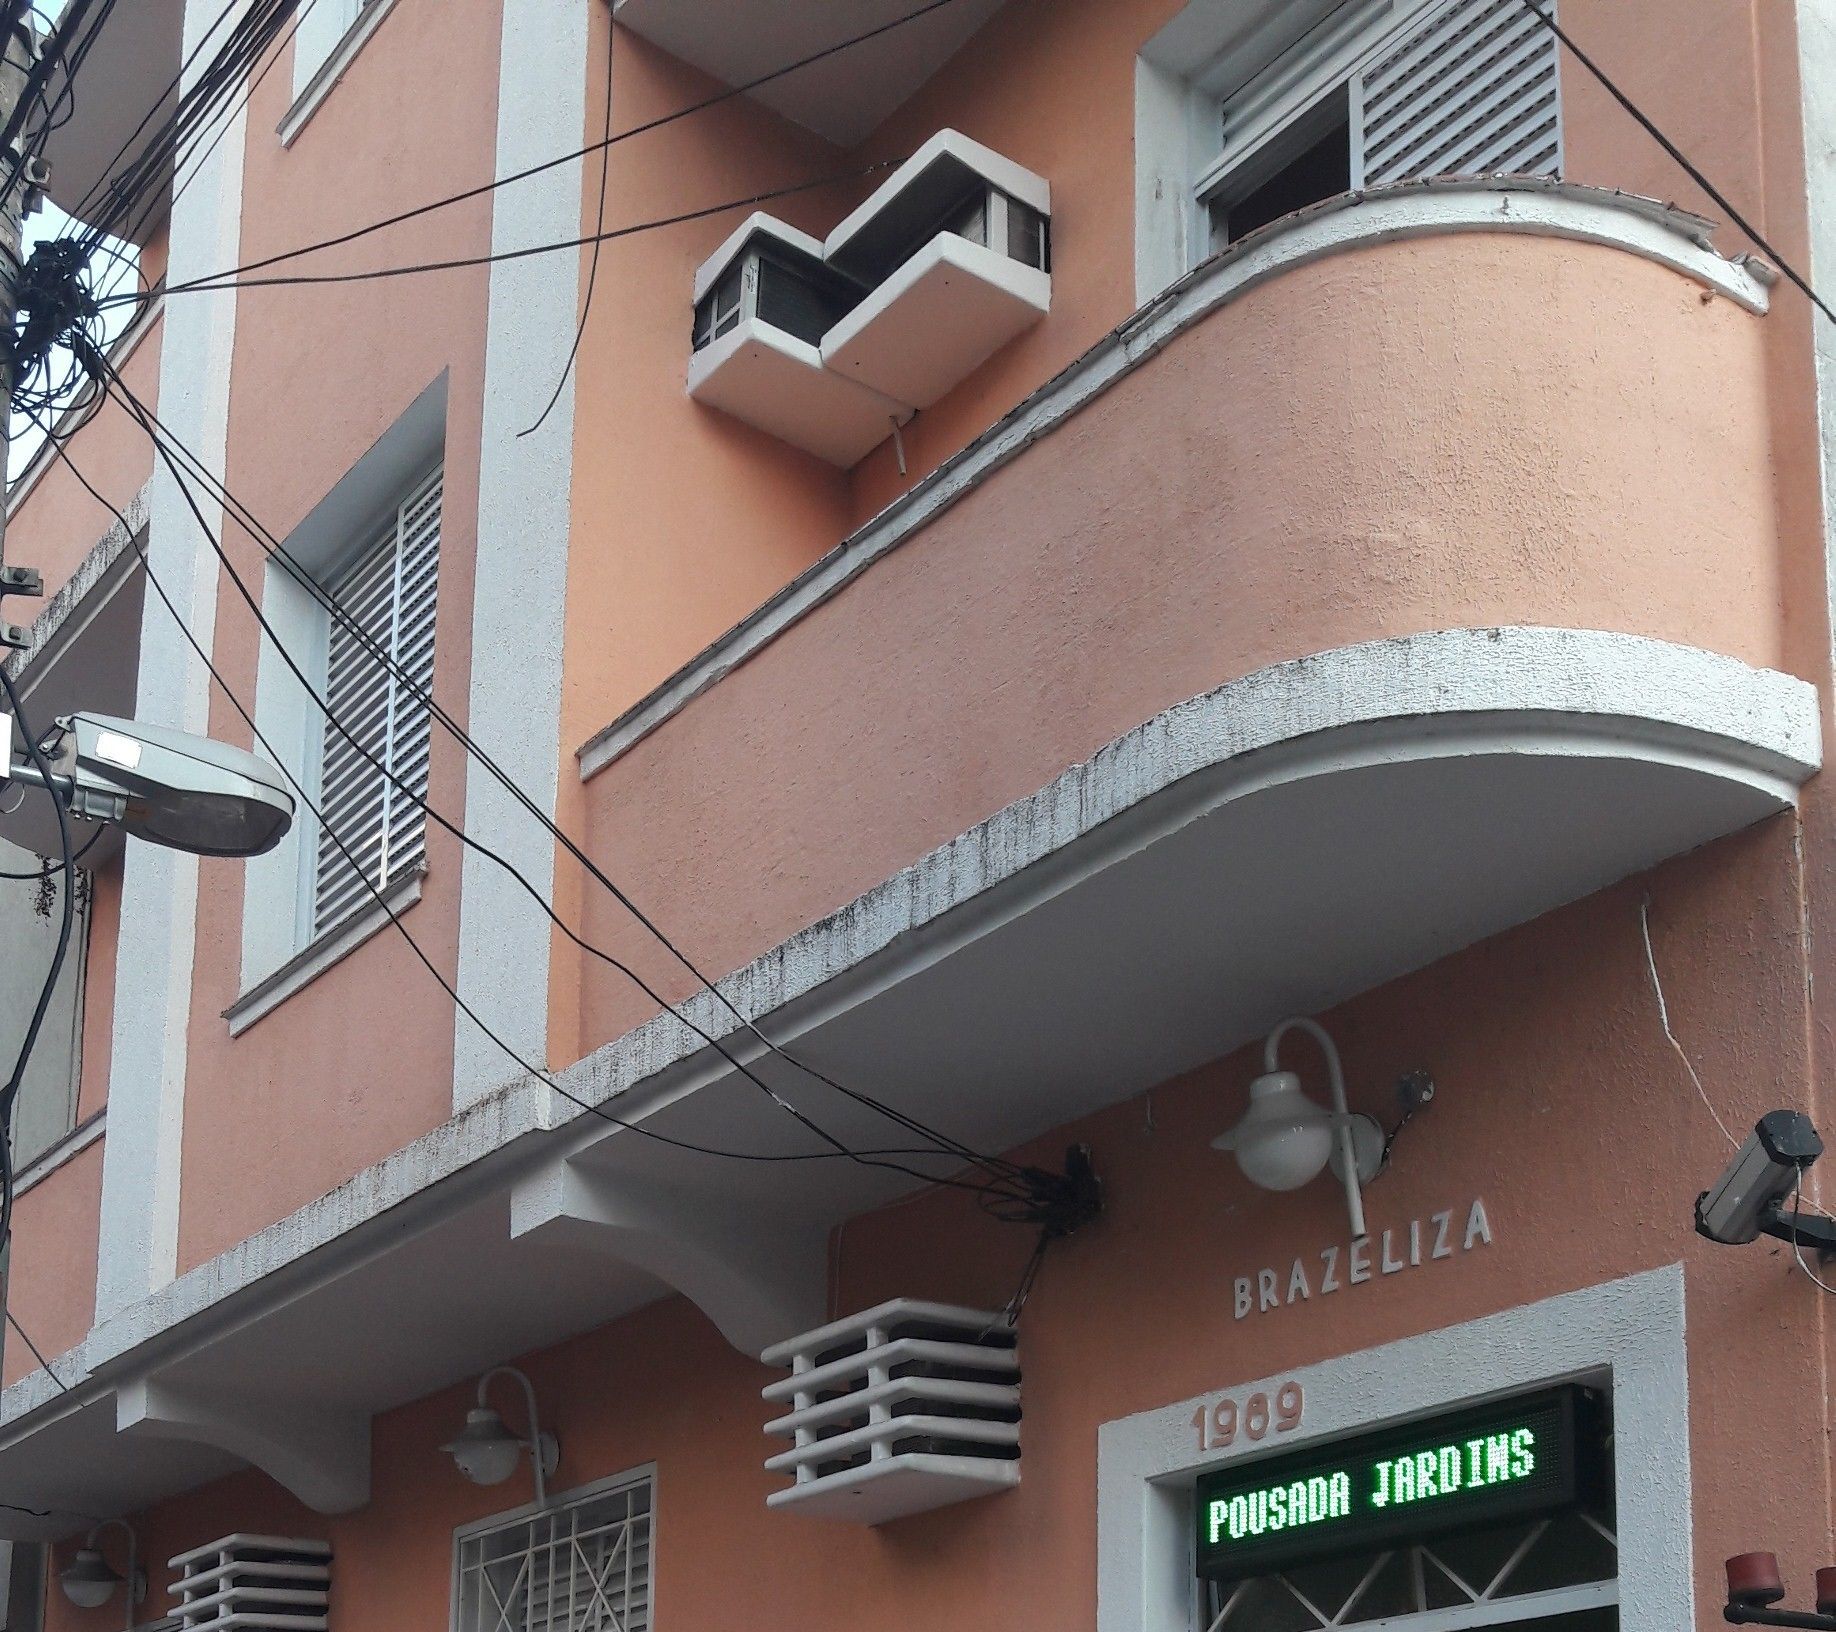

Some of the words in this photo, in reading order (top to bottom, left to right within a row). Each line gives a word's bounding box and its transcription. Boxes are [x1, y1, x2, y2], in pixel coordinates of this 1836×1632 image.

[1233, 1199, 1494, 1320] BRAZELIZA
[1189, 1380, 1304, 1452] 1989
[1208, 1470, 1351, 1544] POUSADA
[1372, 1427, 1537, 1508] JARDINS
